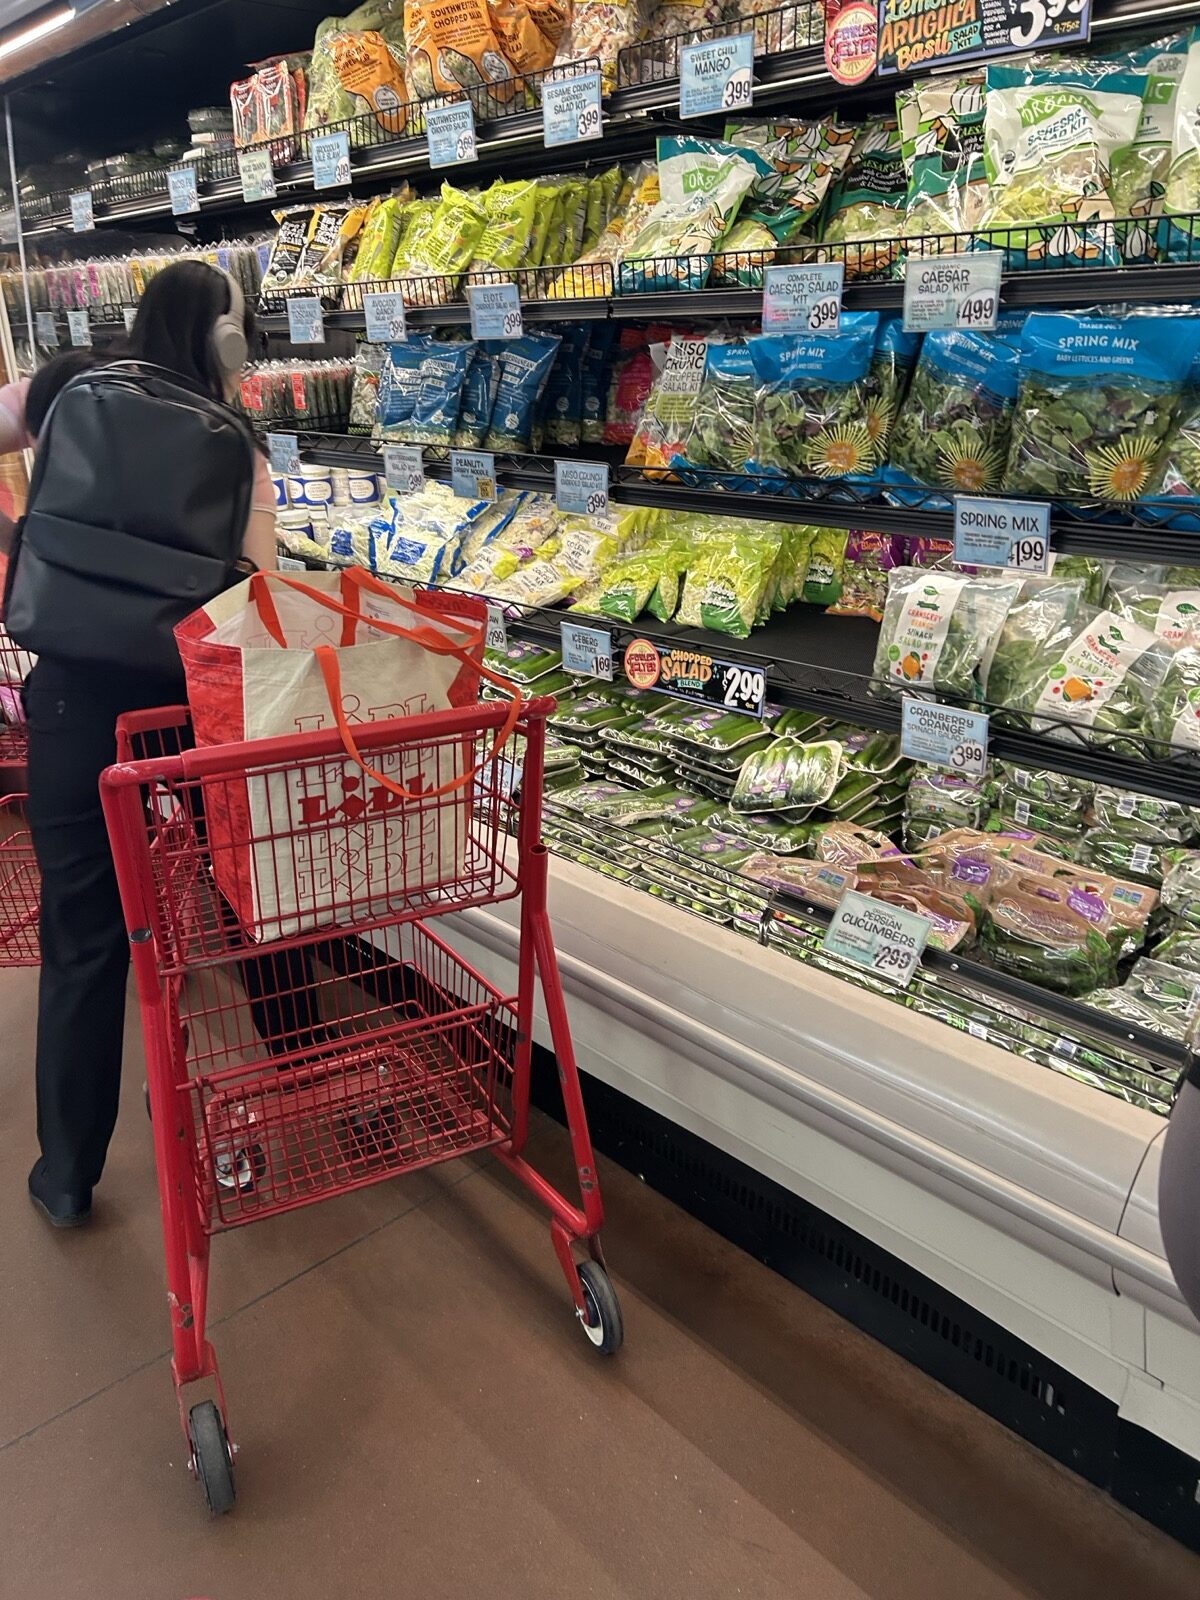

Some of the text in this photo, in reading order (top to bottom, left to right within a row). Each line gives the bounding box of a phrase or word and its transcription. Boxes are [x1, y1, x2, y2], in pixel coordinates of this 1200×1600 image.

[434, 13, 468, 29] CHOPPED
[879, 0, 976, 60] ARUGULA
[953, 25, 979, 43] SALAD
[897, 31, 952, 70] Basil
[957, 37, 972, 49] KIT
[690, 44, 738, 63] SWEET CHILI
[695, 56, 731, 76] MANGO
[547, 82, 597, 99] SESAME CRUNCH
[554, 99, 587, 115] SALAD KIT
[1070, 116, 1088, 133] KIT
[788, 272, 823, 283] COMPLETE
[921, 269, 970, 284] CAESAR
[769, 280, 839, 296] CAESAR SALAD
[918, 283, 970, 295] SALAD KIT
[793, 294, 808, 305] KIT
[675, 342, 706, 356] MISO
[1058, 335, 1139, 351] SPRING MIX
[807, 347, 825, 358] MIX
[665, 357, 704, 370] CRUNC
[662, 382, 687, 392] SALAD
[456, 458, 480, 468] PEANUT
[561, 470, 578, 480] MISO
[960, 511, 1039, 532] SPRING MIX
[572, 633, 598, 647] ICEBERG
[907, 628, 934, 640] SPINACH
[627, 653, 657, 665] FEARLESS
[671, 649, 713, 666] CHOPPED
[1066, 655, 1099, 674] SALAD
[629, 662, 657, 678] FLYER
[662, 656, 713, 683] SALAD
[680, 680, 701, 688] BLEND
[910, 706, 974, 729] CRANBERRY
[906, 722, 936, 737] SPINACH
[919, 717, 965, 736] ORANGE
[863, 910, 902, 930] PERSIAN
[842, 912, 915, 948] CUCUMBERS
